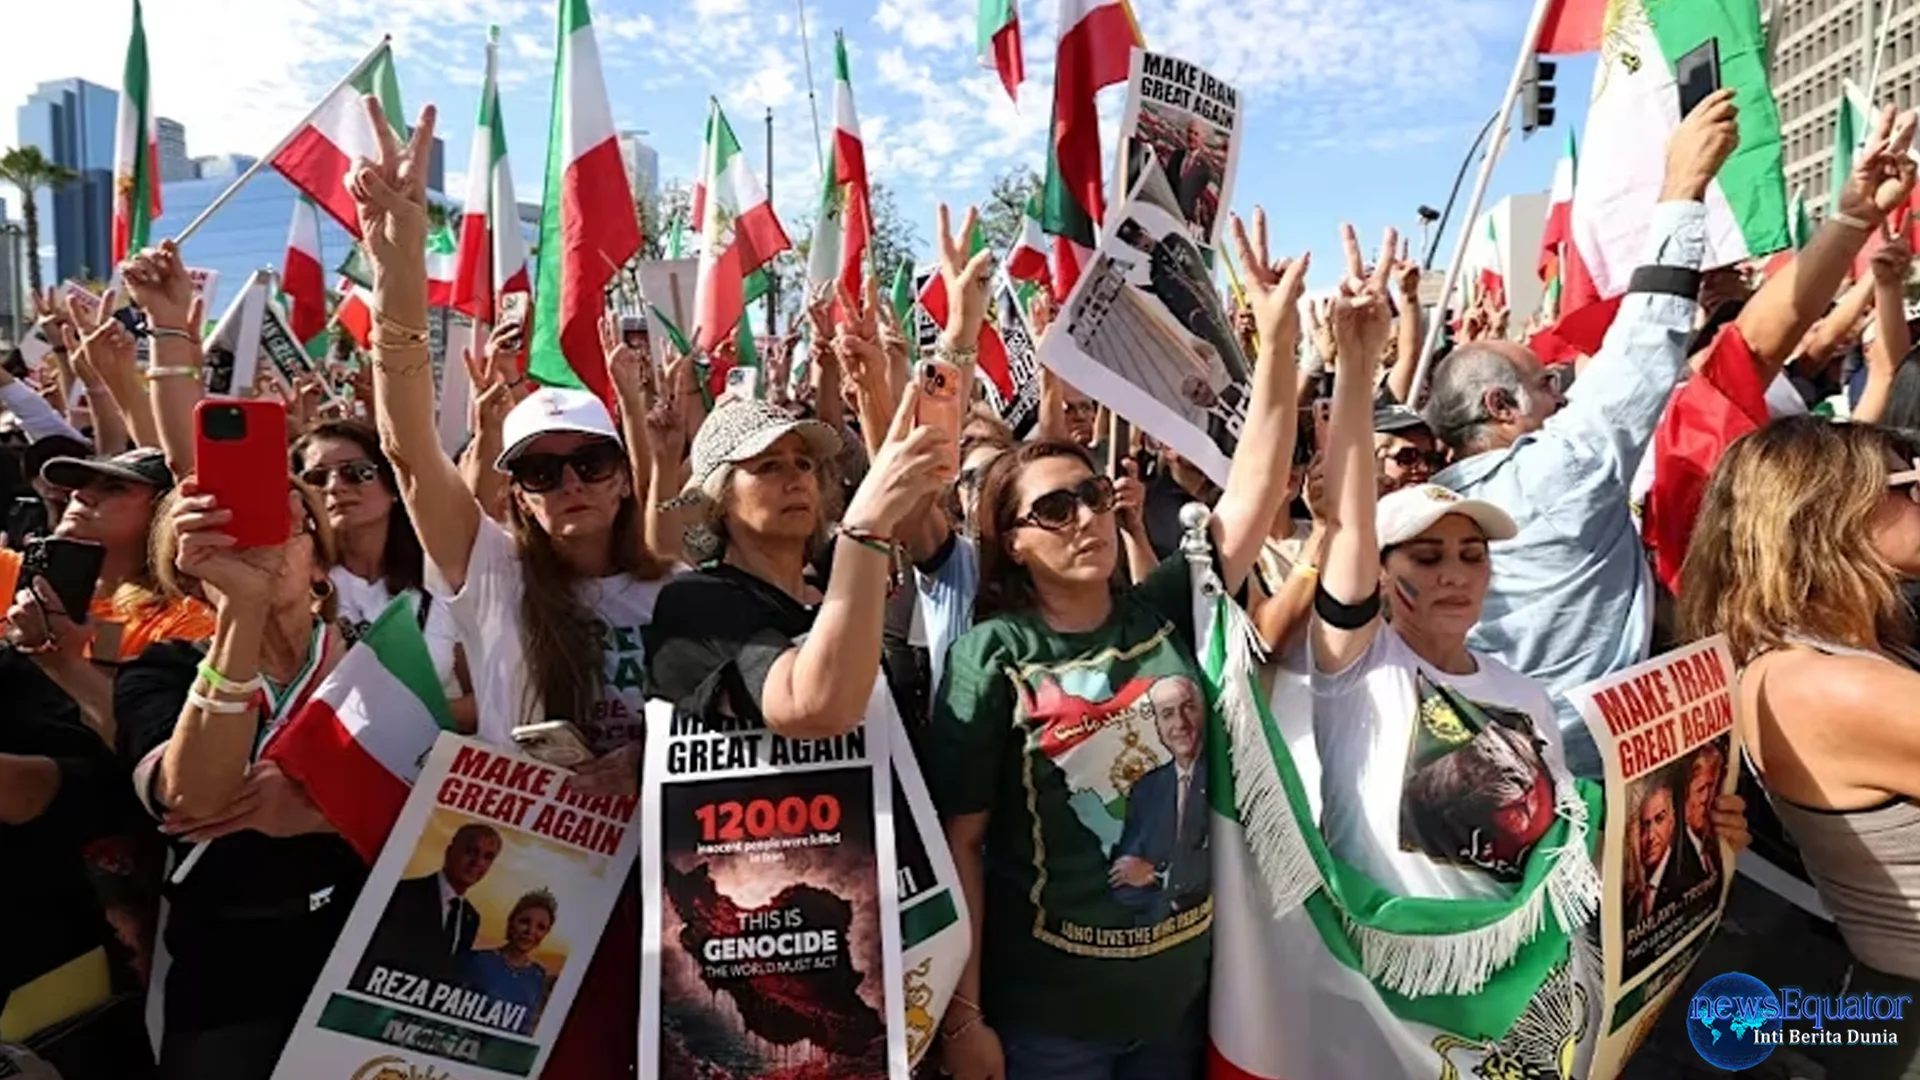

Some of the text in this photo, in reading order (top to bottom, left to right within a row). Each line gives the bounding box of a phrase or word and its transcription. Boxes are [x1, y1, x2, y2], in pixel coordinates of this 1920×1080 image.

[1140, 76, 1237, 131] GREAT AGAIN
[1142, 51, 1237, 110] MAKE IRAN
[1591, 646, 1727, 737] MAKE IRAN
[666, 734, 763, 776] GREAT
[769, 725, 866, 767] AGAIN
[1617, 692, 1733, 780] GREAT AGAIN
[449, 745, 556, 797] MAKE
[436, 777, 626, 857] GREAT AGAIN
[694, 793, 841, 841] 12000
[703, 929, 838, 962] GENOCIDE
[735, 908, 803, 931] THIS IS
[1095, 928, 1127, 946] LIVE
[1127, 927, 1151, 945] THE
[705, 955, 838, 978] THE WORLD MUST ACT
[364, 965, 528, 1031] REZA PAHLAVI
